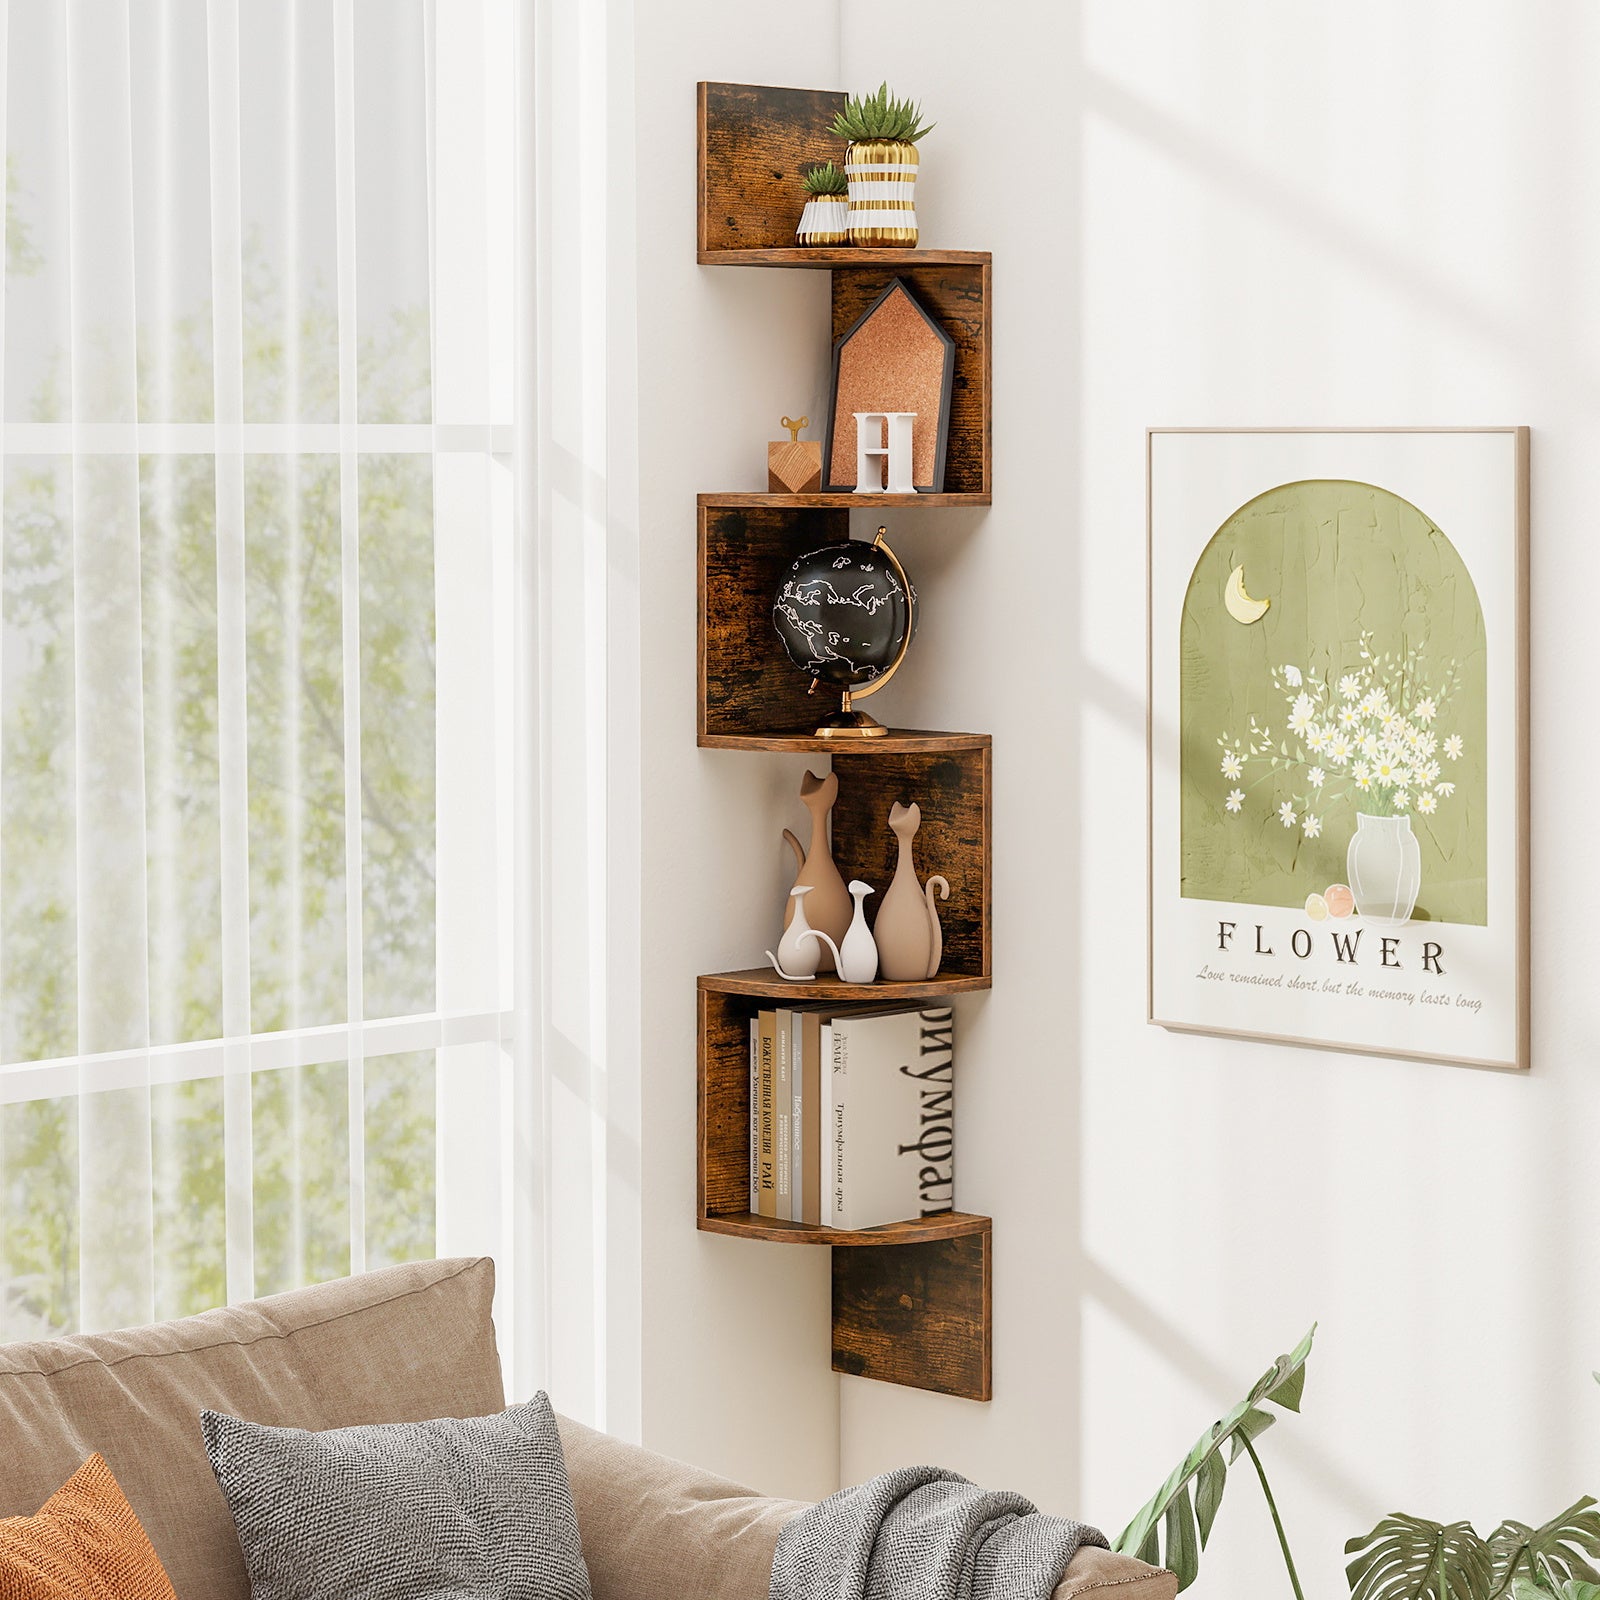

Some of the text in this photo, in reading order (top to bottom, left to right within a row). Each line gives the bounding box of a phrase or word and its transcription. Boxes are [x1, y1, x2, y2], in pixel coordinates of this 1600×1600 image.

[852, 412, 918, 494] H
[1196, 964, 1226, 982] Love
[1229, 968, 1282, 988] remained
[1346, 982, 1364, 997] the
[1368, 987, 1416, 1005] memory
[1420, 989, 1451, 1006] lasts
[1456, 993, 1484, 1014] long
[1217, 921, 1447, 976] FLOWER
[762, 1036, 774, 1190] БОЖЕСТВЕННАЯ КОМЕДИЯ РАЙ
[835, 1103, 845, 1212] Триумфальная арка
